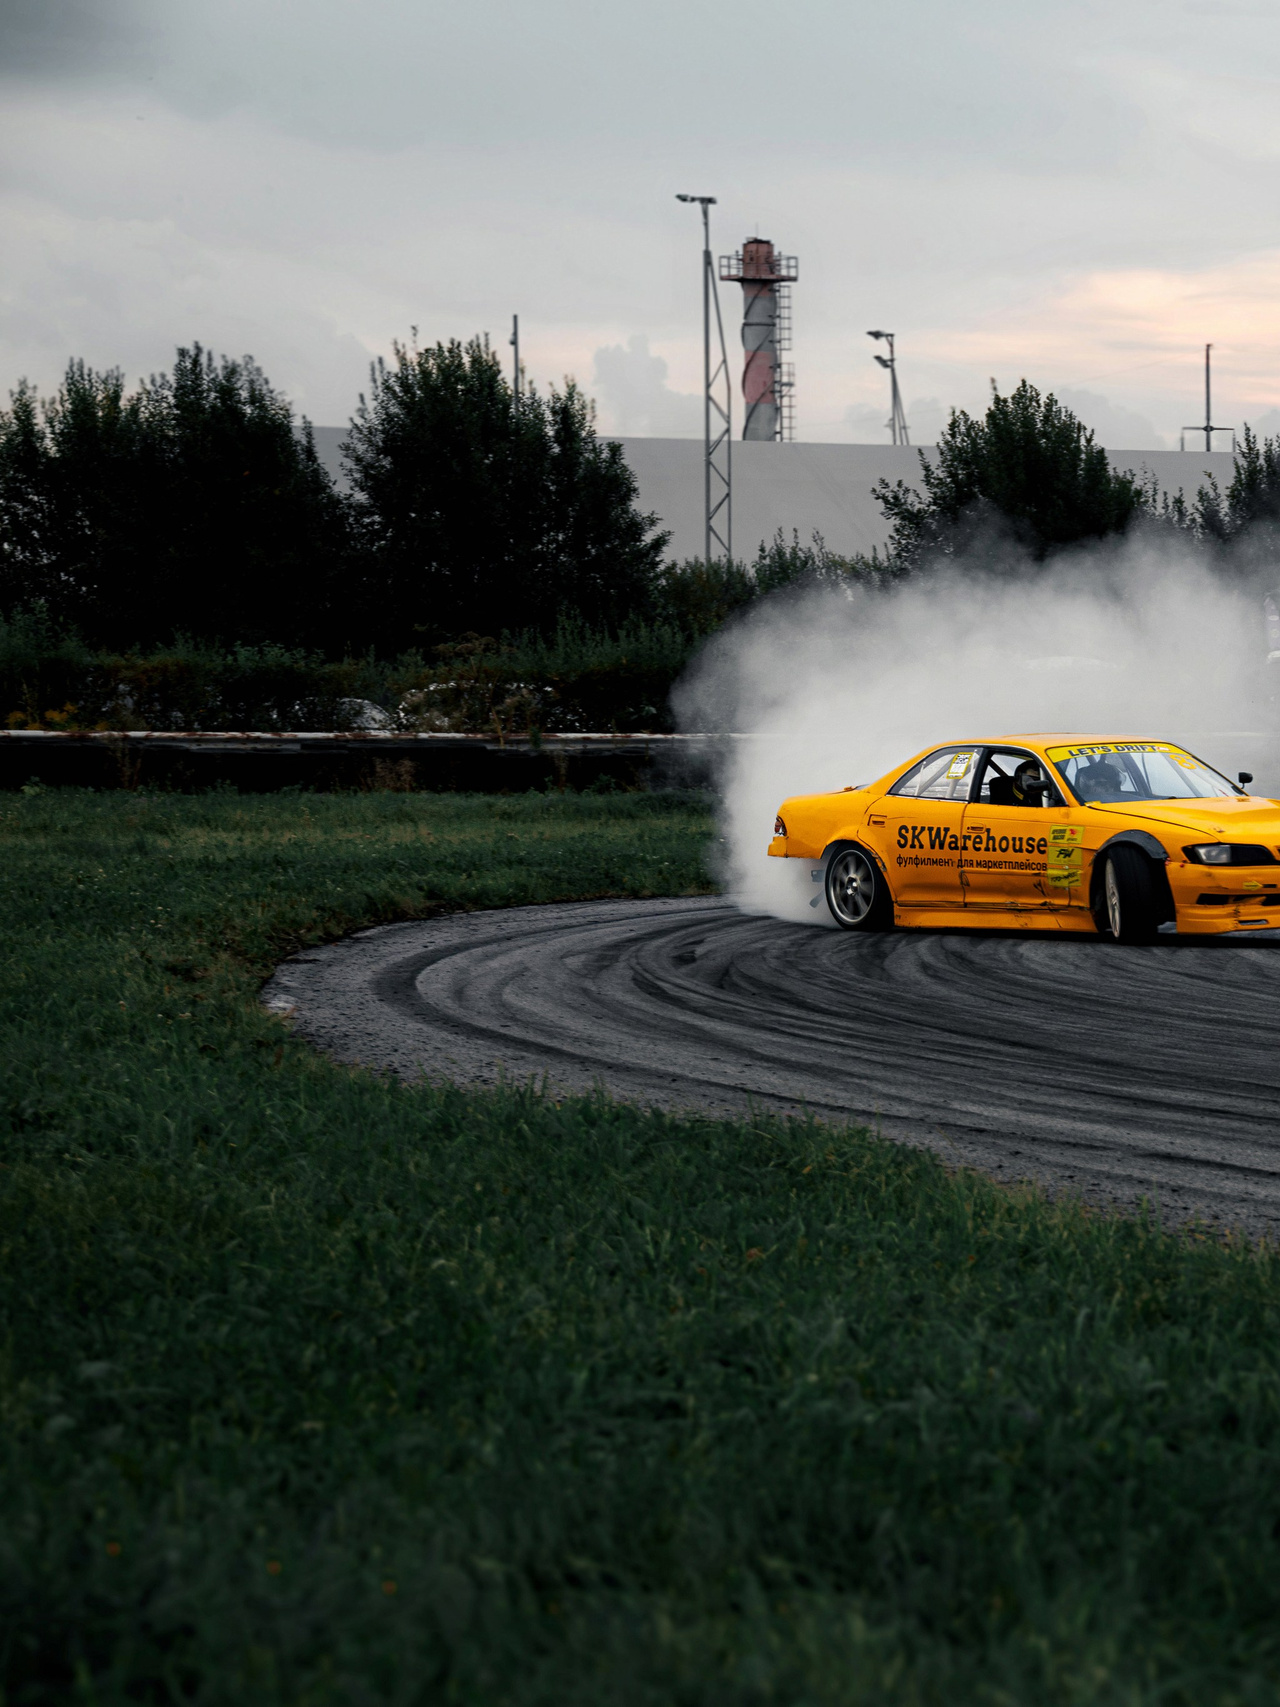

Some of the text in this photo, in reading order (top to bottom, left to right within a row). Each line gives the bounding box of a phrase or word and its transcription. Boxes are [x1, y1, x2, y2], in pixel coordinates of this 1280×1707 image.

[1068, 745, 1112, 757] LET'S
[1113, 744, 1157, 753] DRIFT
[1168, 754, 1207, 771] 81
[897, 825, 1048, 854] SKWarehouse
[896, 853, 1048, 872] фулфилмент для маркетплейсов
